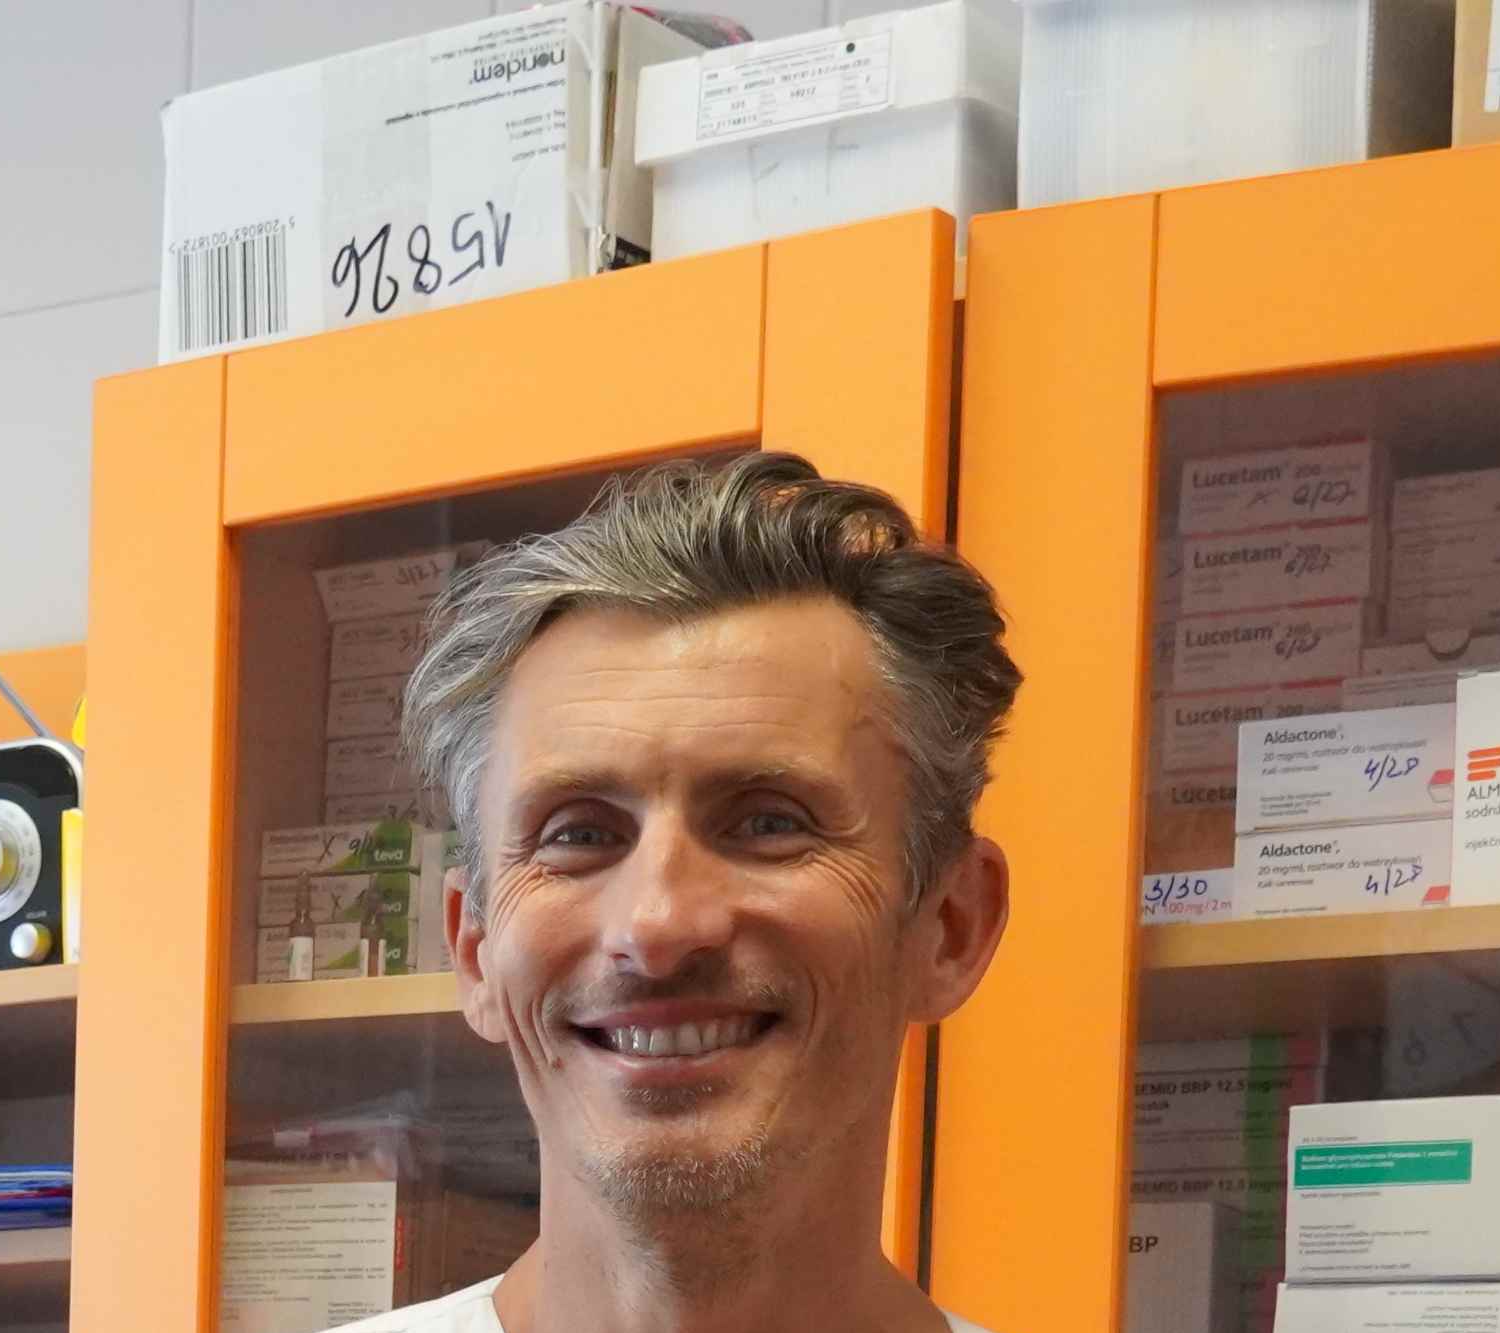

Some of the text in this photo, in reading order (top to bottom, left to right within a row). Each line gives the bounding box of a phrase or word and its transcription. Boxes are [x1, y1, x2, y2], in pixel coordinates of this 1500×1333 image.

[332, 201, 513, 318] 15826
[1193, 546, 1282, 569] Lucetam
[1184, 624, 1272, 649] Lucetam
[1170, 785, 1237, 805] Luceta
